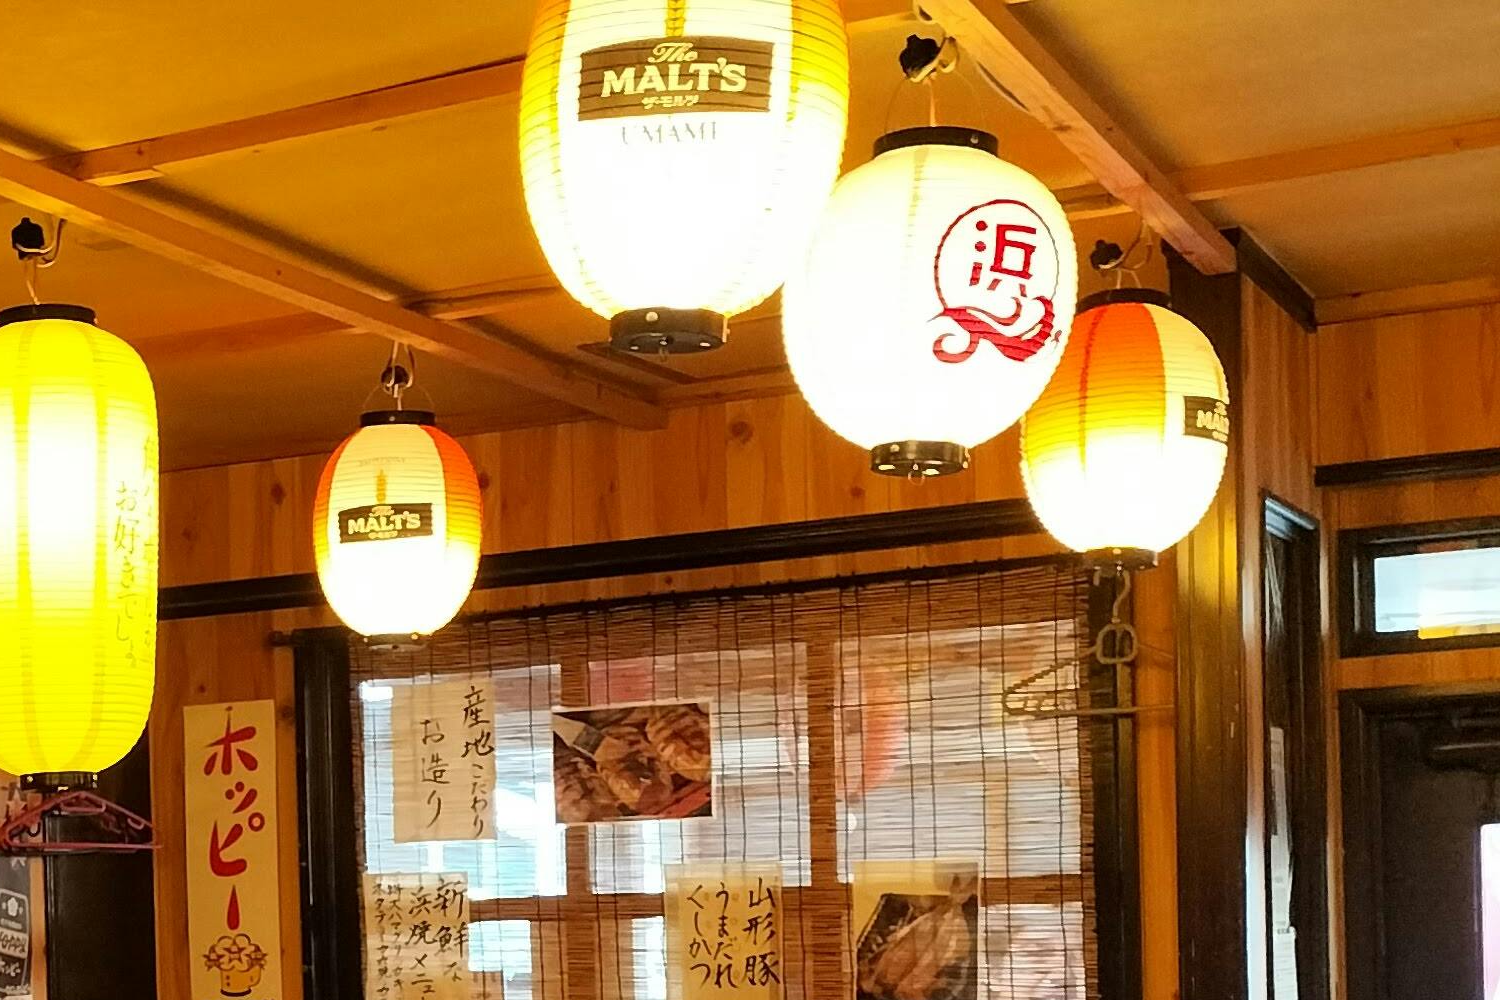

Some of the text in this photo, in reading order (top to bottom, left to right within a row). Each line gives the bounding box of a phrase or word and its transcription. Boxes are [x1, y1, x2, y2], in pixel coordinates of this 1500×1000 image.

[601, 58, 747, 98] MALT'S
[648, 43, 698, 63] The
[348, 511, 420, 534] MALT'S
[421, 718, 450, 828] お造り
[461, 685, 495, 838] 産地こだわり
[204, 710, 265, 931] ホッピー
[434, 881, 469, 983] 新鮮な
[686, 885, 711, 989] くしかつ
[714, 882, 738, 989] うまだれ
[742, 877, 780, 986] 山形豚
